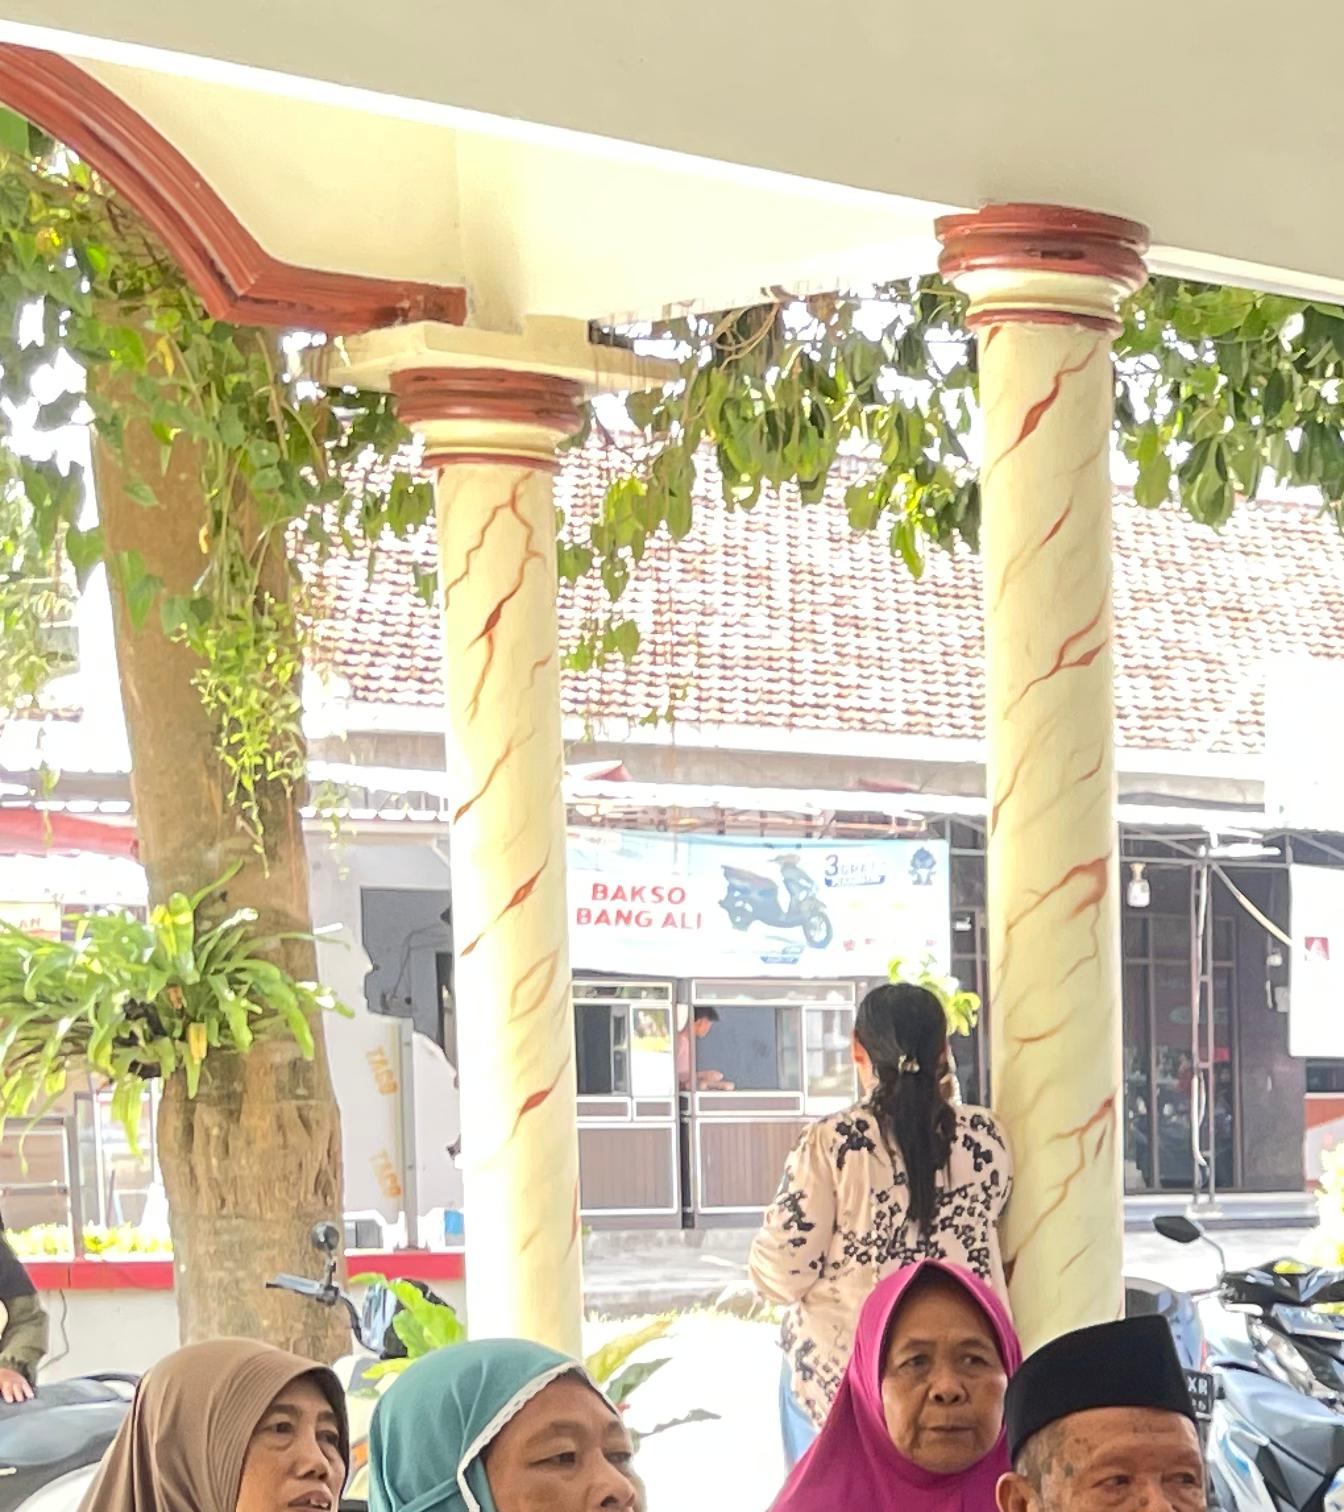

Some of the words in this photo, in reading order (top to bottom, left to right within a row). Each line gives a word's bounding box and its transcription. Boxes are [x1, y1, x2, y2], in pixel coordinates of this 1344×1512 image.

[591, 883, 686, 905] BAKSO
[576, 907, 653, 928] BANG
[660, 911, 702, 930] ALI
